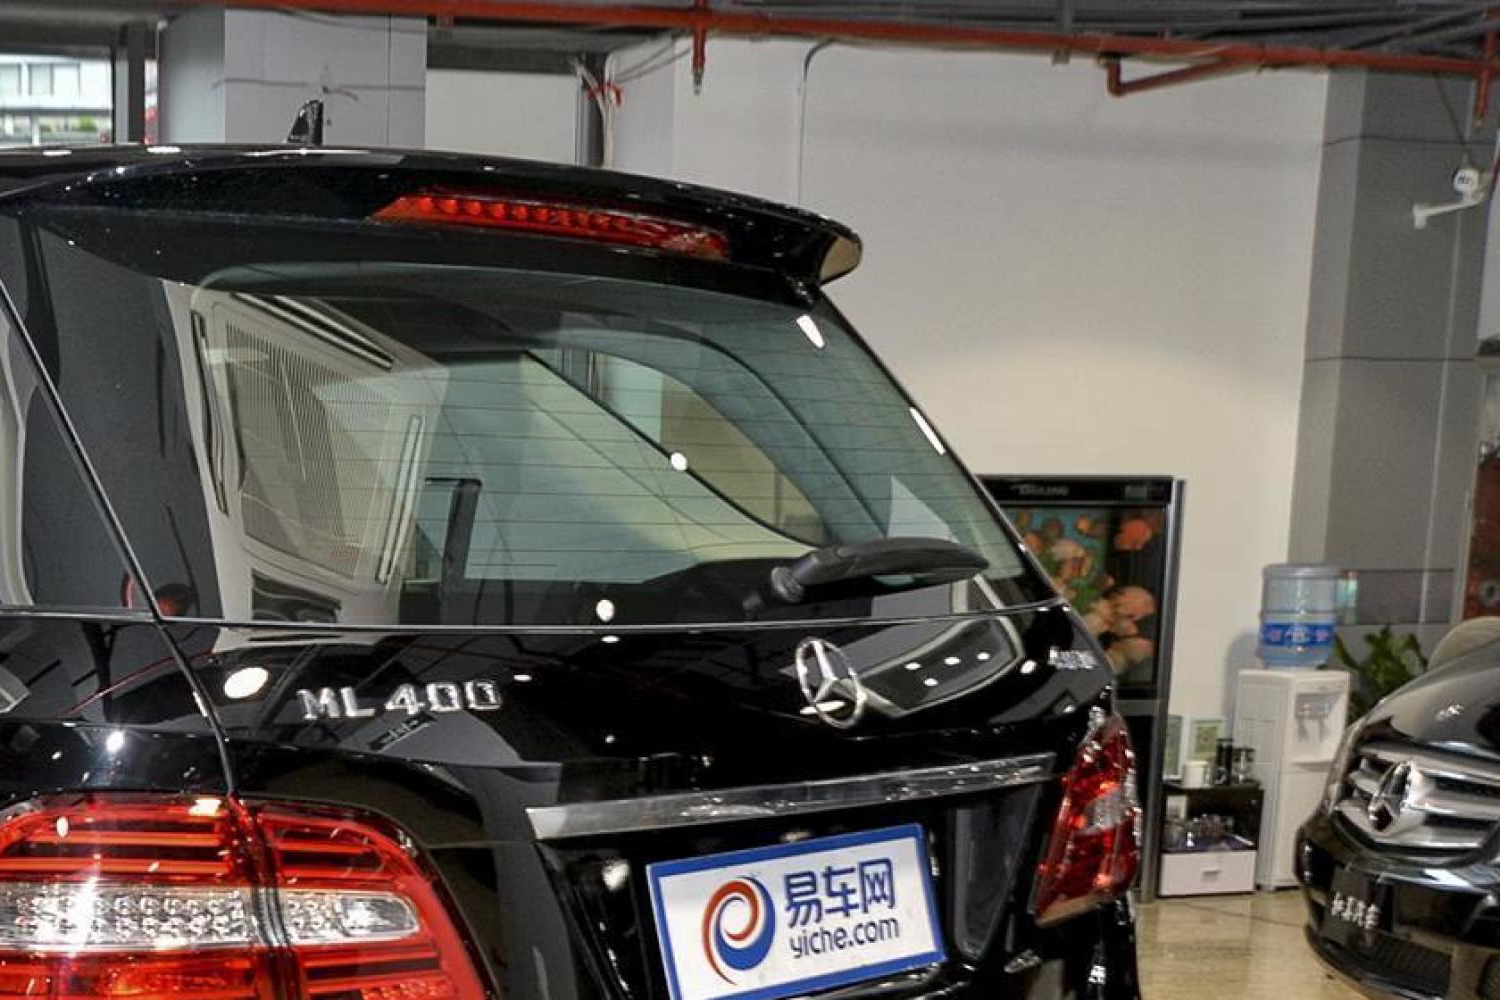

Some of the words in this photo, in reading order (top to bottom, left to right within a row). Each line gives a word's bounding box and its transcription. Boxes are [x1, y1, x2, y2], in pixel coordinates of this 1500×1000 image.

[297, 686, 376, 720] ML
[384, 679, 501, 716] 400
[784, 857, 896, 929] 易车网
[788, 917, 900, 960] yiche.com
